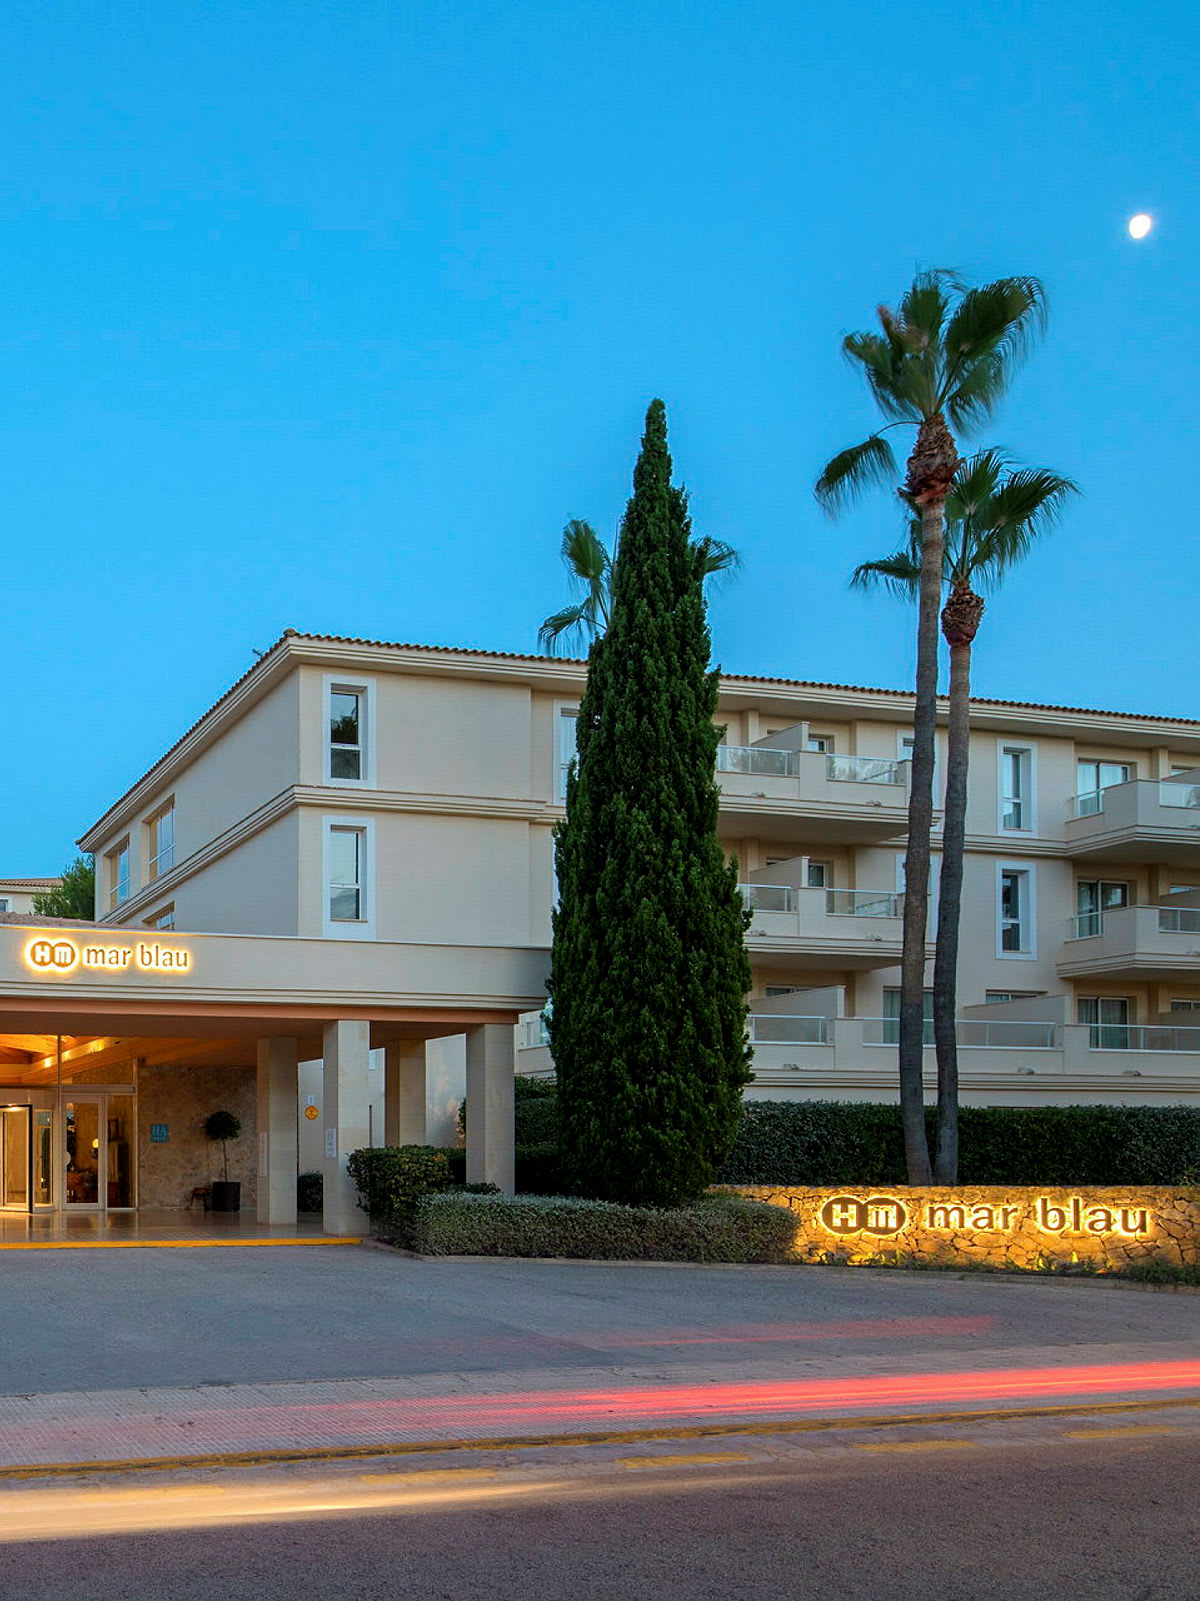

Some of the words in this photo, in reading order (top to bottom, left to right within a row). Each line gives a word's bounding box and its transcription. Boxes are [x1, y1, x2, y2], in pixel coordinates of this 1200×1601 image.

[86, 948, 131, 965] mar
[140, 944, 188, 967] blau
[928, 1202, 1018, 1230] mar
[1040, 1197, 1147, 1233] blau
